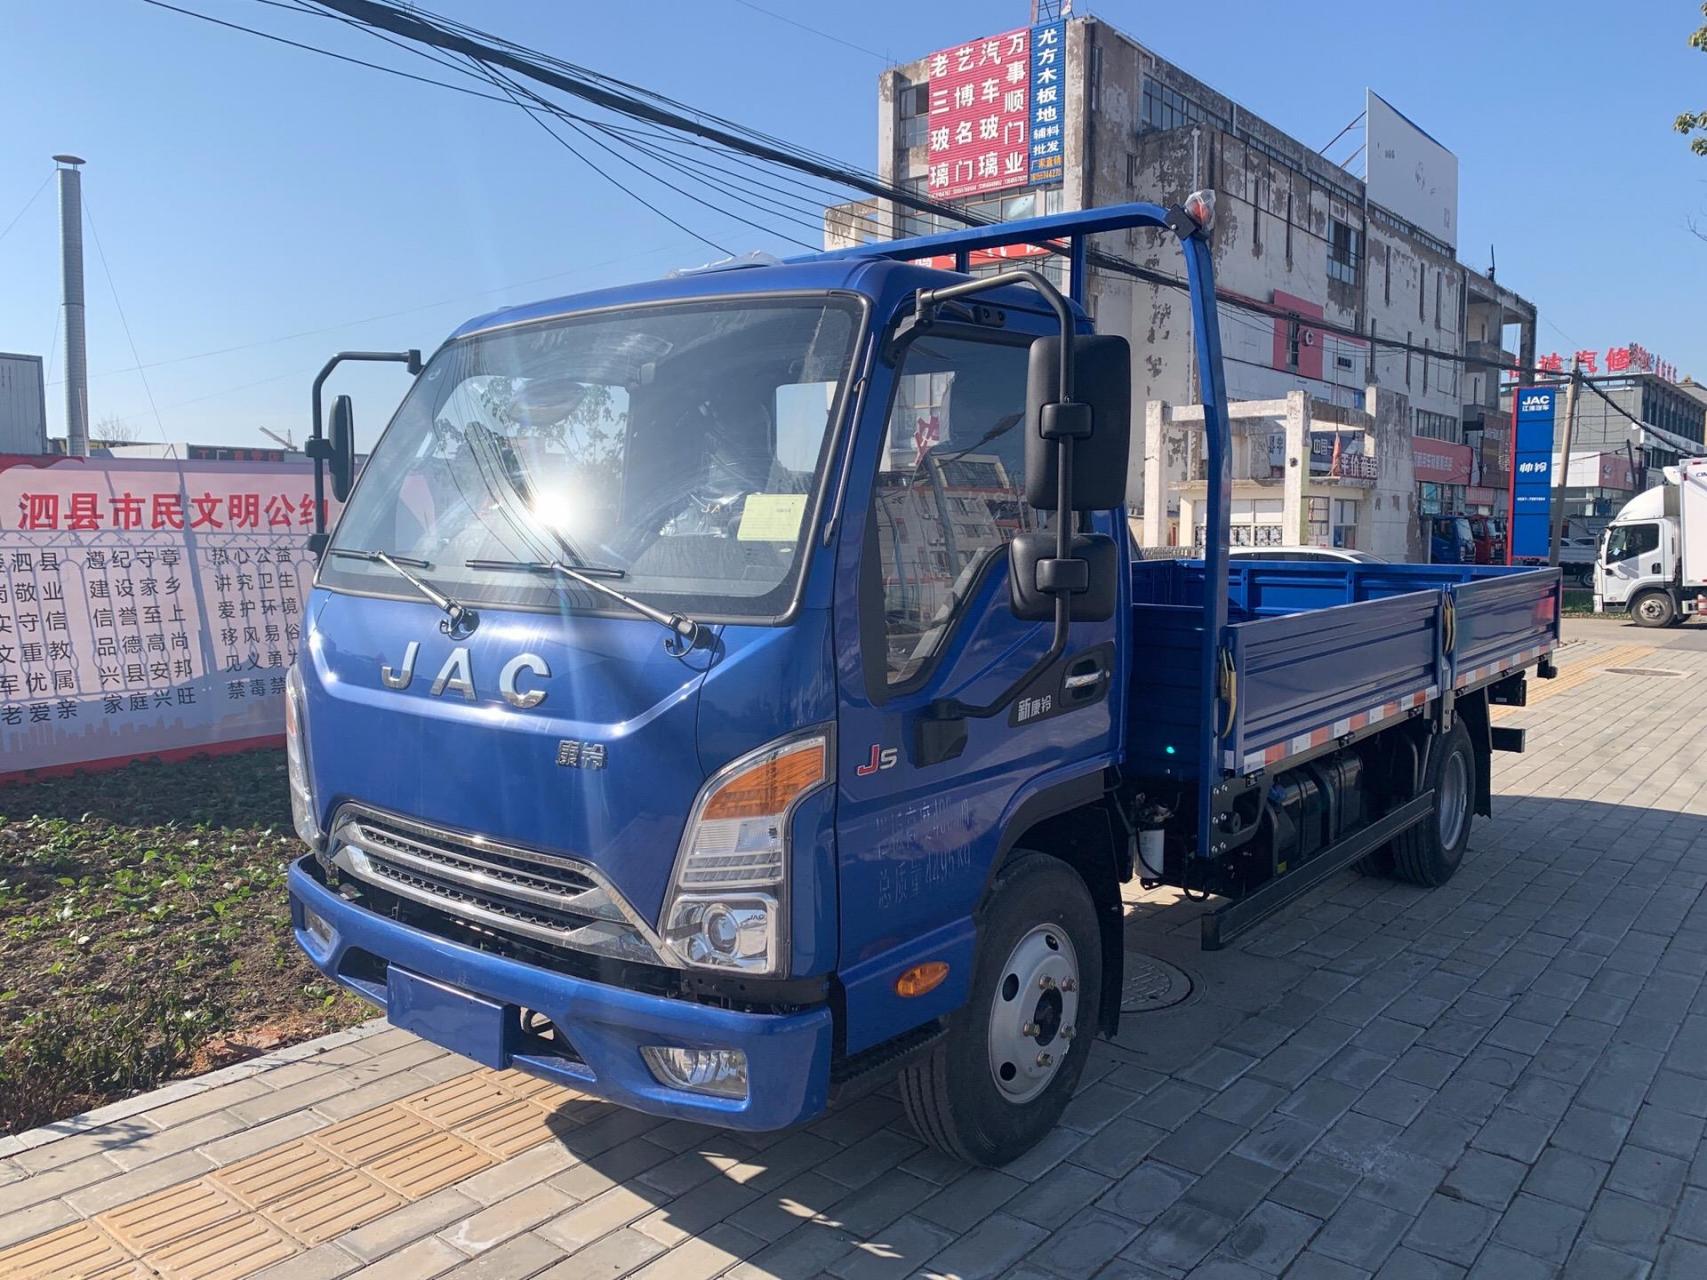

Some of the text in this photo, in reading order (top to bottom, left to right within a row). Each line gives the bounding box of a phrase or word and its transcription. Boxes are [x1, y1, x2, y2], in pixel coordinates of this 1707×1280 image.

[954, 47, 975, 182] 艺博名门
[978, 40, 1001, 178] 汽车玻璃
[1004, 31, 1027, 174] 万事顺门业
[930, 54, 949, 188] 老三玻璃
[1033, 141, 1059, 156] 批发
[1522, 395, 1550, 405] JAC
[18, 492, 328, 531] 泗县市民文明公约
[0, 546, 291, 574] 泗县 遵纪守章 热心公益
[89, 576, 181, 599] 建设家乡
[215, 572, 295, 592] 讲究卫生
[93, 604, 186, 628] 信誉至上
[218, 597, 298, 618] 爱护环境
[98, 631, 188, 657] 品德高尚
[221, 624, 299, 646] 移风易俗
[100, 659, 192, 685] 兴县安邦
[381, 641, 552, 708] JAC
[1, 700, 78, 726] 老爱亲
[103, 687, 196, 714] 家庭兴旺
